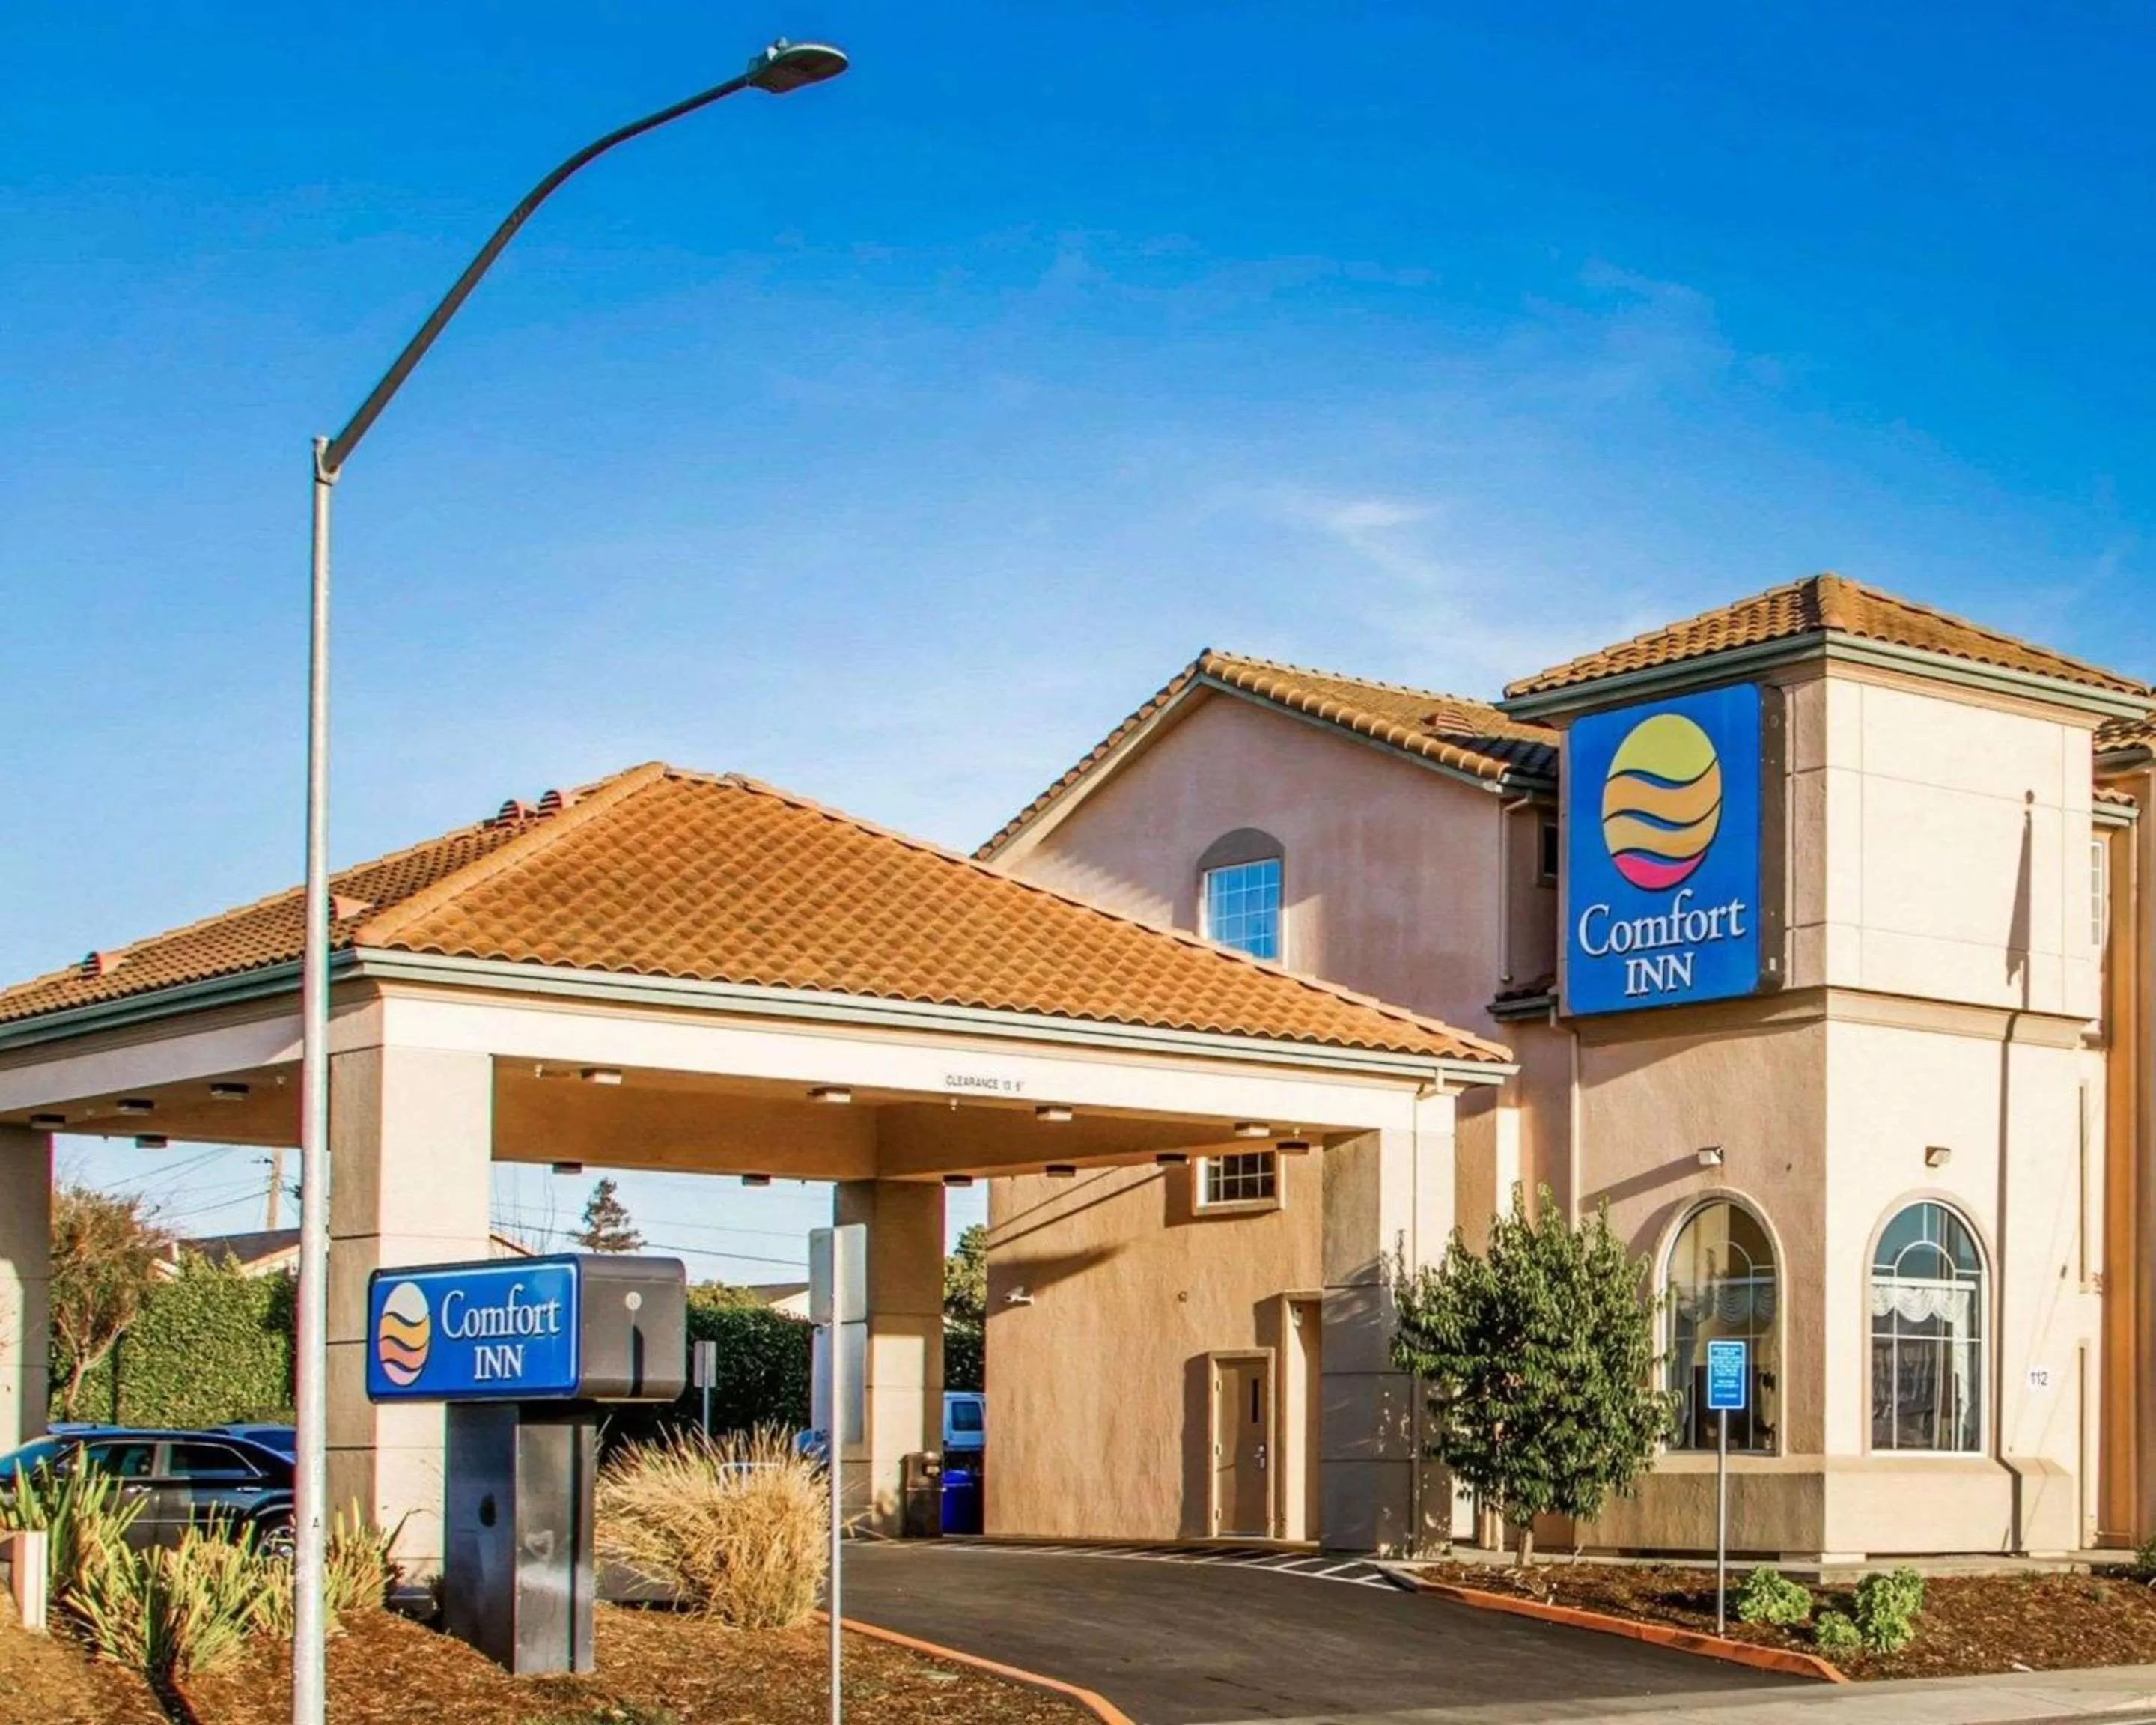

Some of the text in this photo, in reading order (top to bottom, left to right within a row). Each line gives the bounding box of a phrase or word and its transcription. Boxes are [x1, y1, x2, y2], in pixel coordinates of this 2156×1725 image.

[1579, 889, 1746, 955] Comfort
[1624, 952, 1694, 995] INN
[945, 1074, 999, 1090] CLEARANCE
[442, 1283, 561, 1338] Comfort
[474, 1345, 524, 1379] INN
[2030, 1371, 2048, 1386] 112
